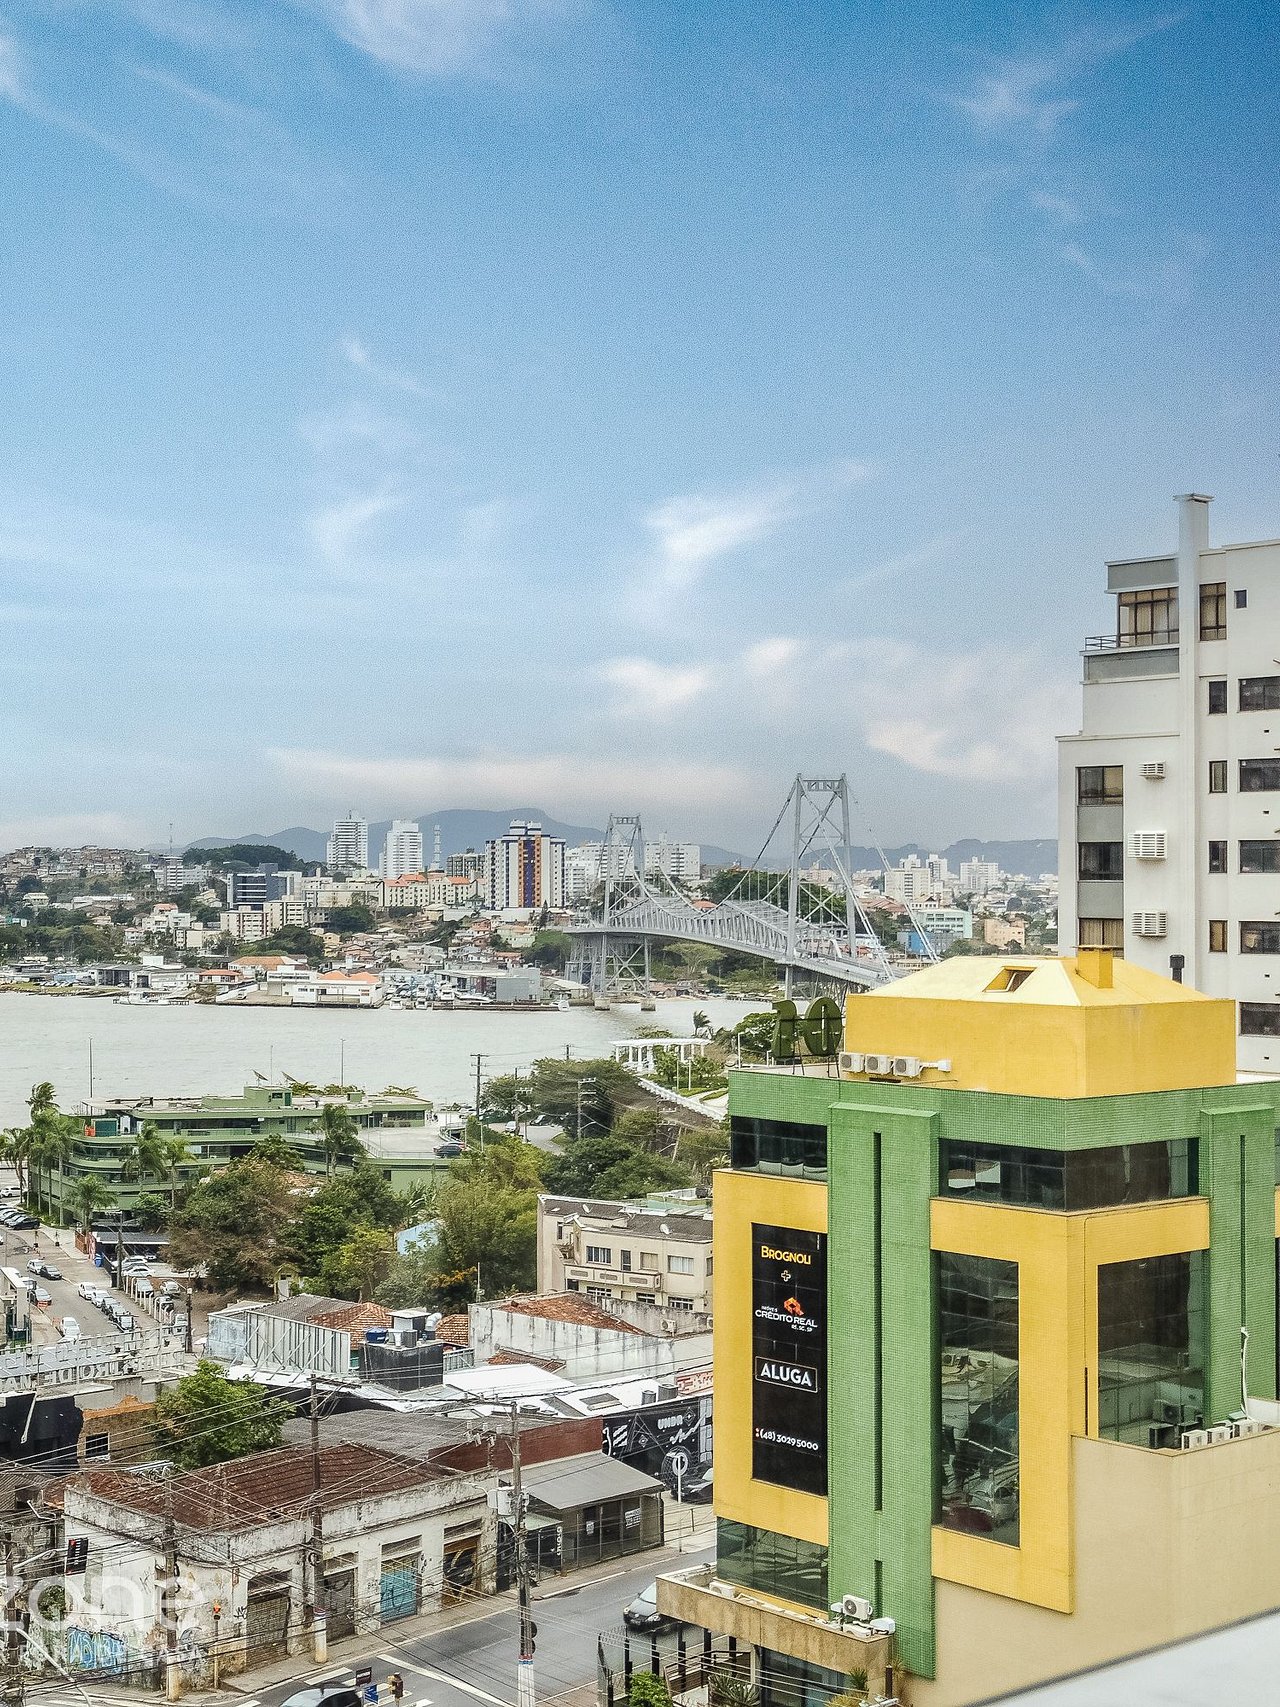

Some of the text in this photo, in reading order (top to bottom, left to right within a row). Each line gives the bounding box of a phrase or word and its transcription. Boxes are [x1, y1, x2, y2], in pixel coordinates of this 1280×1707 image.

[754, 1309, 818, 1328] CRÉDITO REAL
[760, 1363, 812, 1387] ALUGA
